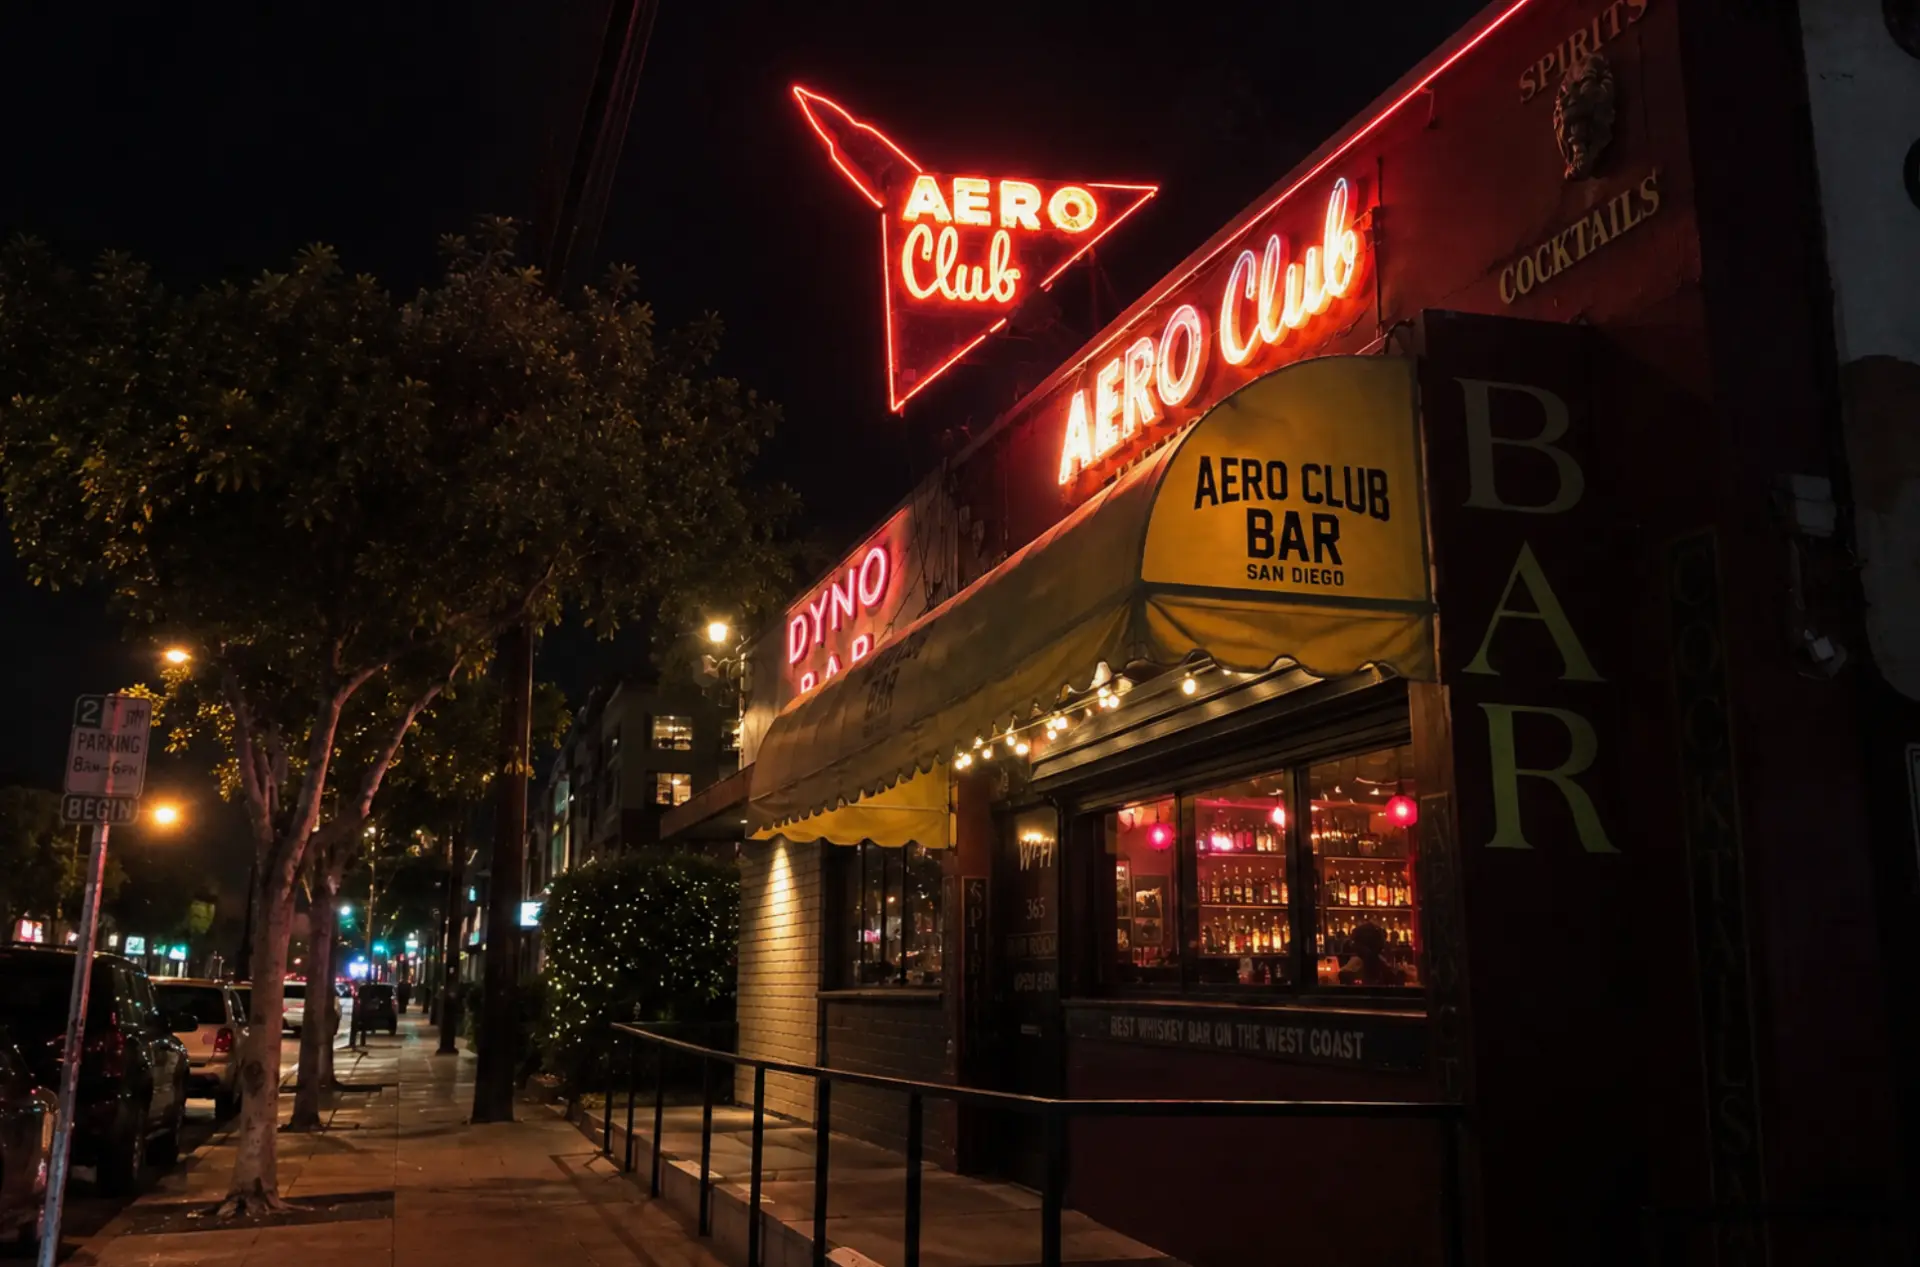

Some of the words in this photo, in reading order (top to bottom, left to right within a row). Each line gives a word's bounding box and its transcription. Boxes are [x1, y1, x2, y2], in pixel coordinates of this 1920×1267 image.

[1519, 0, 1648, 104] SPIRITS
[903, 174, 1098, 234] AERO
[901, 222, 1022, 303] Club
[1500, 172, 1661, 306] COCKTAILS
[1057, 303, 1207, 486] AERO
[1219, 176, 1363, 367] Club
[1194, 455, 1288, 510] AERO
[1301, 463, 1390, 522] CLUB
[1246, 507, 1343, 566] BAR
[789, 545, 890, 665] DYNO
[1246, 563, 1285, 582] SAN
[1291, 567, 1345, 587] DIEGO
[1452, 376, 1622, 855] BAR
[77, 731, 141, 755] PARKING
[81, 700, 100, 724] 2
[67, 797, 132, 820] BEGIN
[1110, 1015, 1136, 1038] BEST
[1137, 1017, 1184, 1042] WHISKEY
[1187, 1020, 1212, 1045] BAR
[1214, 1021, 1234, 1048] ON
[1235, 1023, 1261, 1051] THE
[1263, 1025, 1306, 1055] WEST
[1309, 1026, 1365, 1061] COAST
